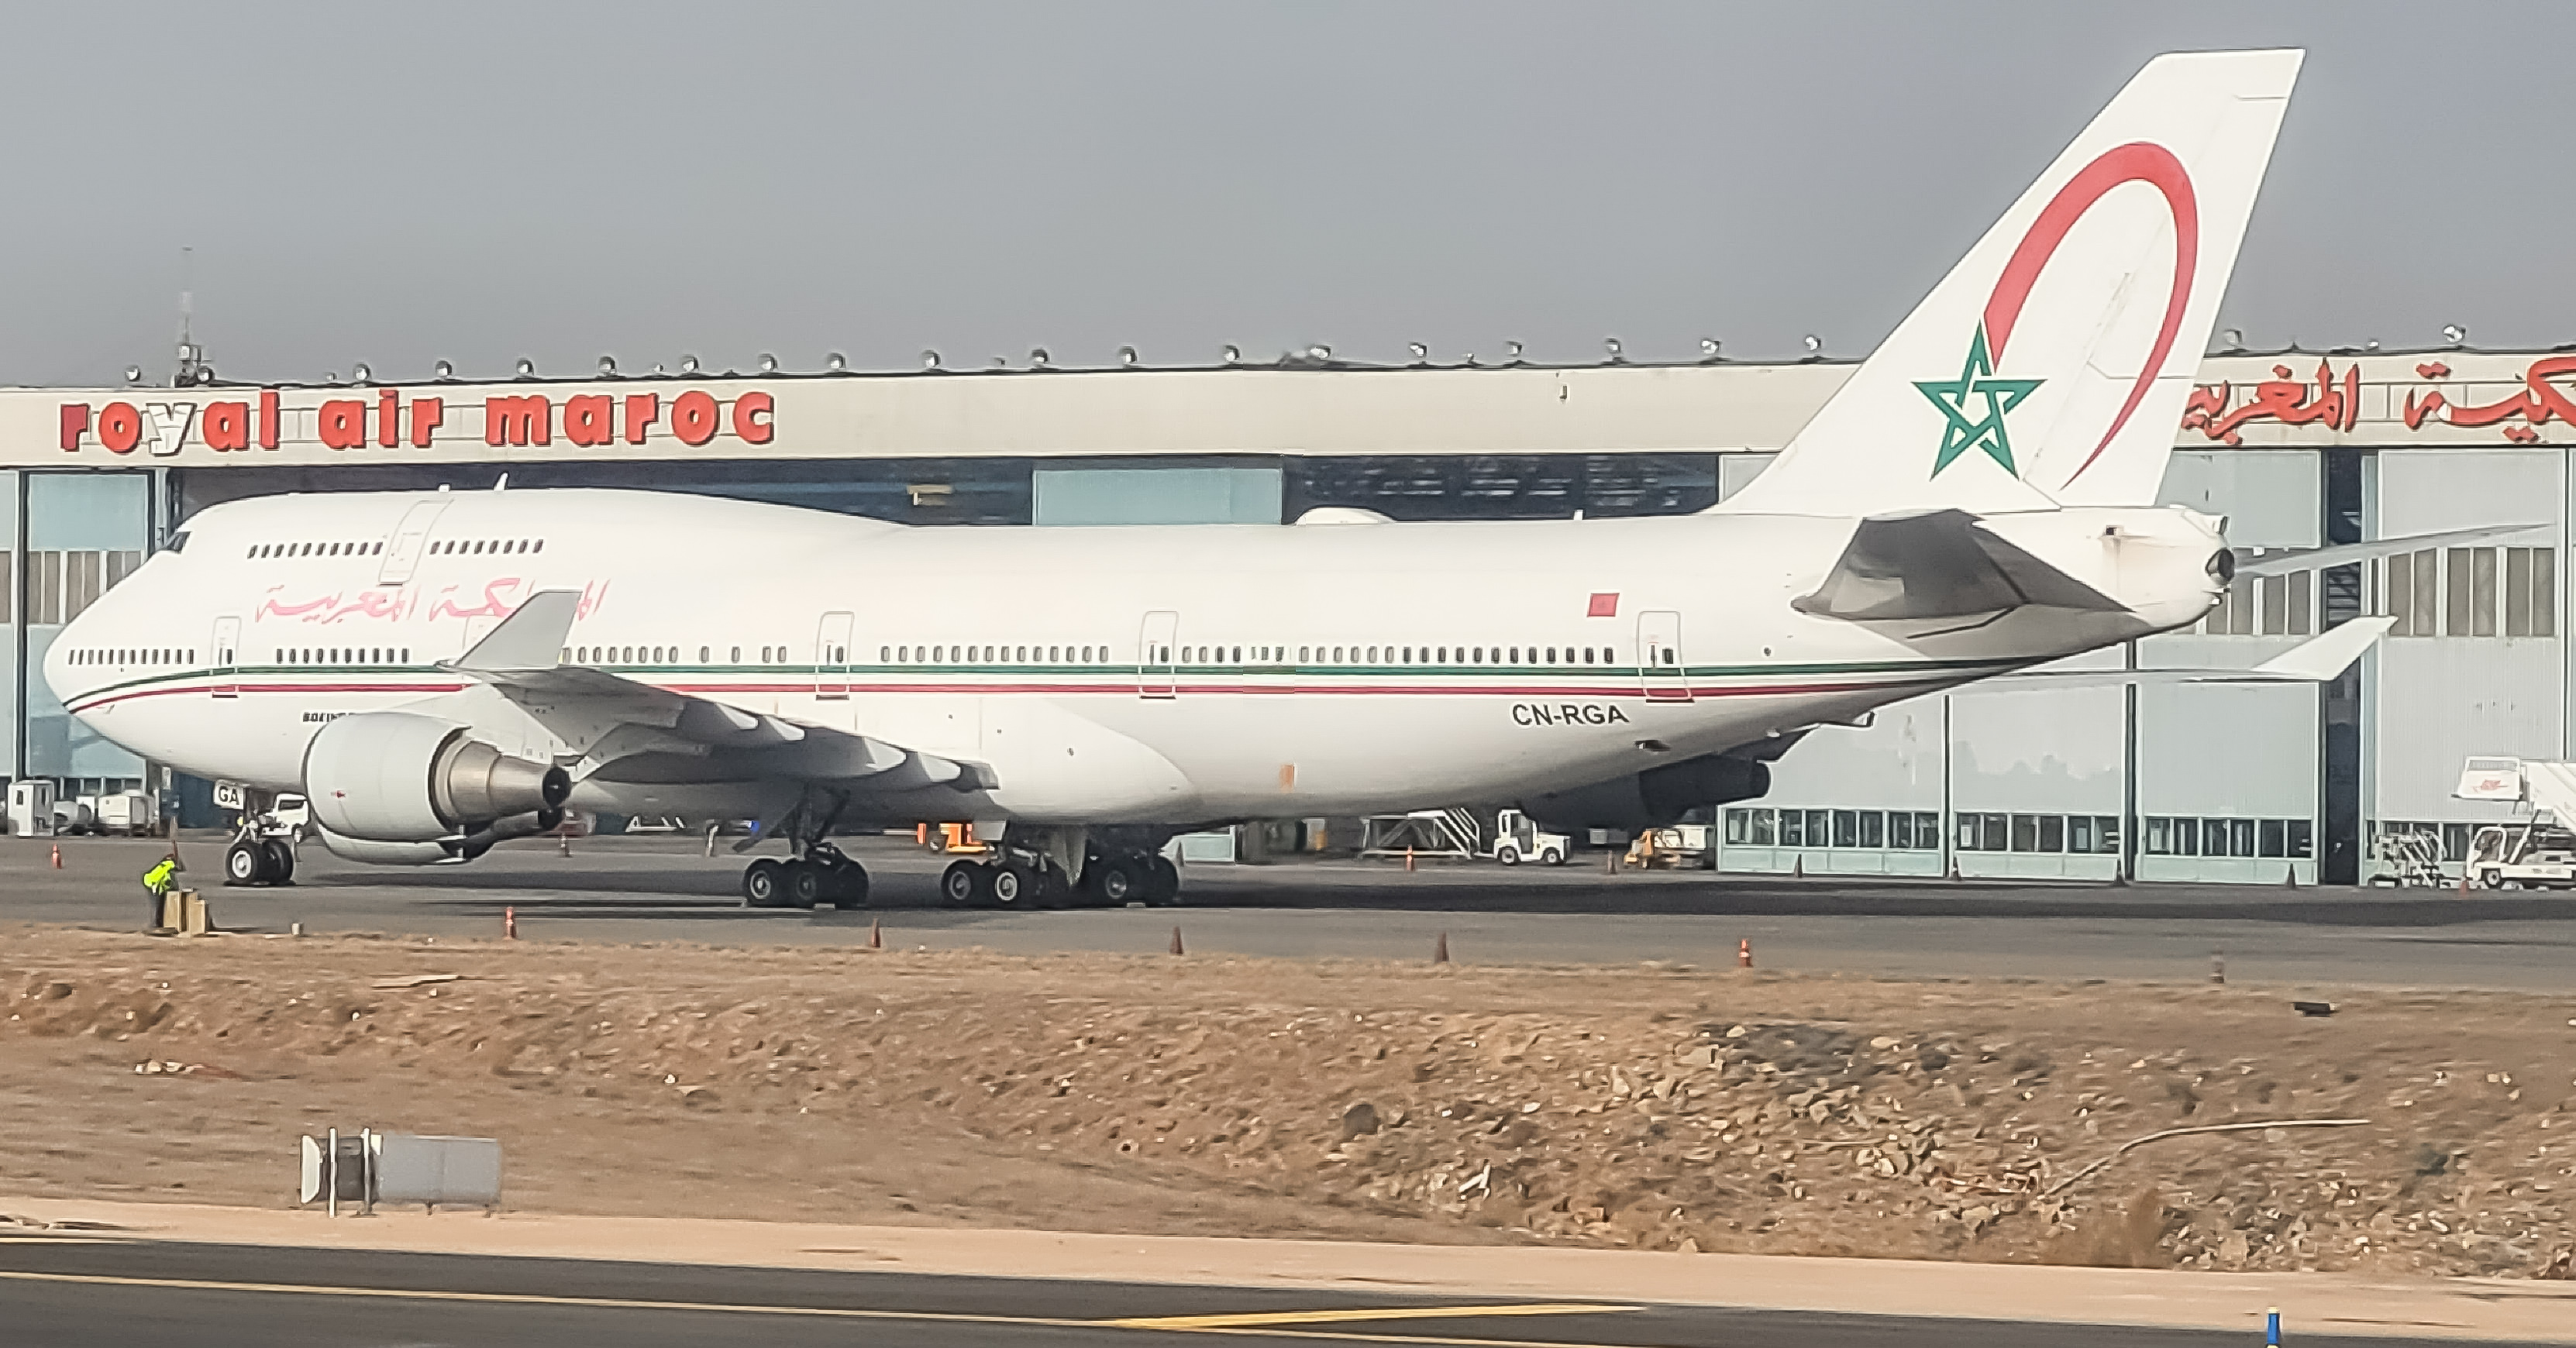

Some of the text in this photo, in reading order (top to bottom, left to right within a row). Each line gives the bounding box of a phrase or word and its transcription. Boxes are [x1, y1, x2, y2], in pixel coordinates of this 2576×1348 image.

[60, 387, 774, 457] royal air maroc
[1512, 703, 1630, 726] CN-RGA
[218, 786, 240, 806] GA
